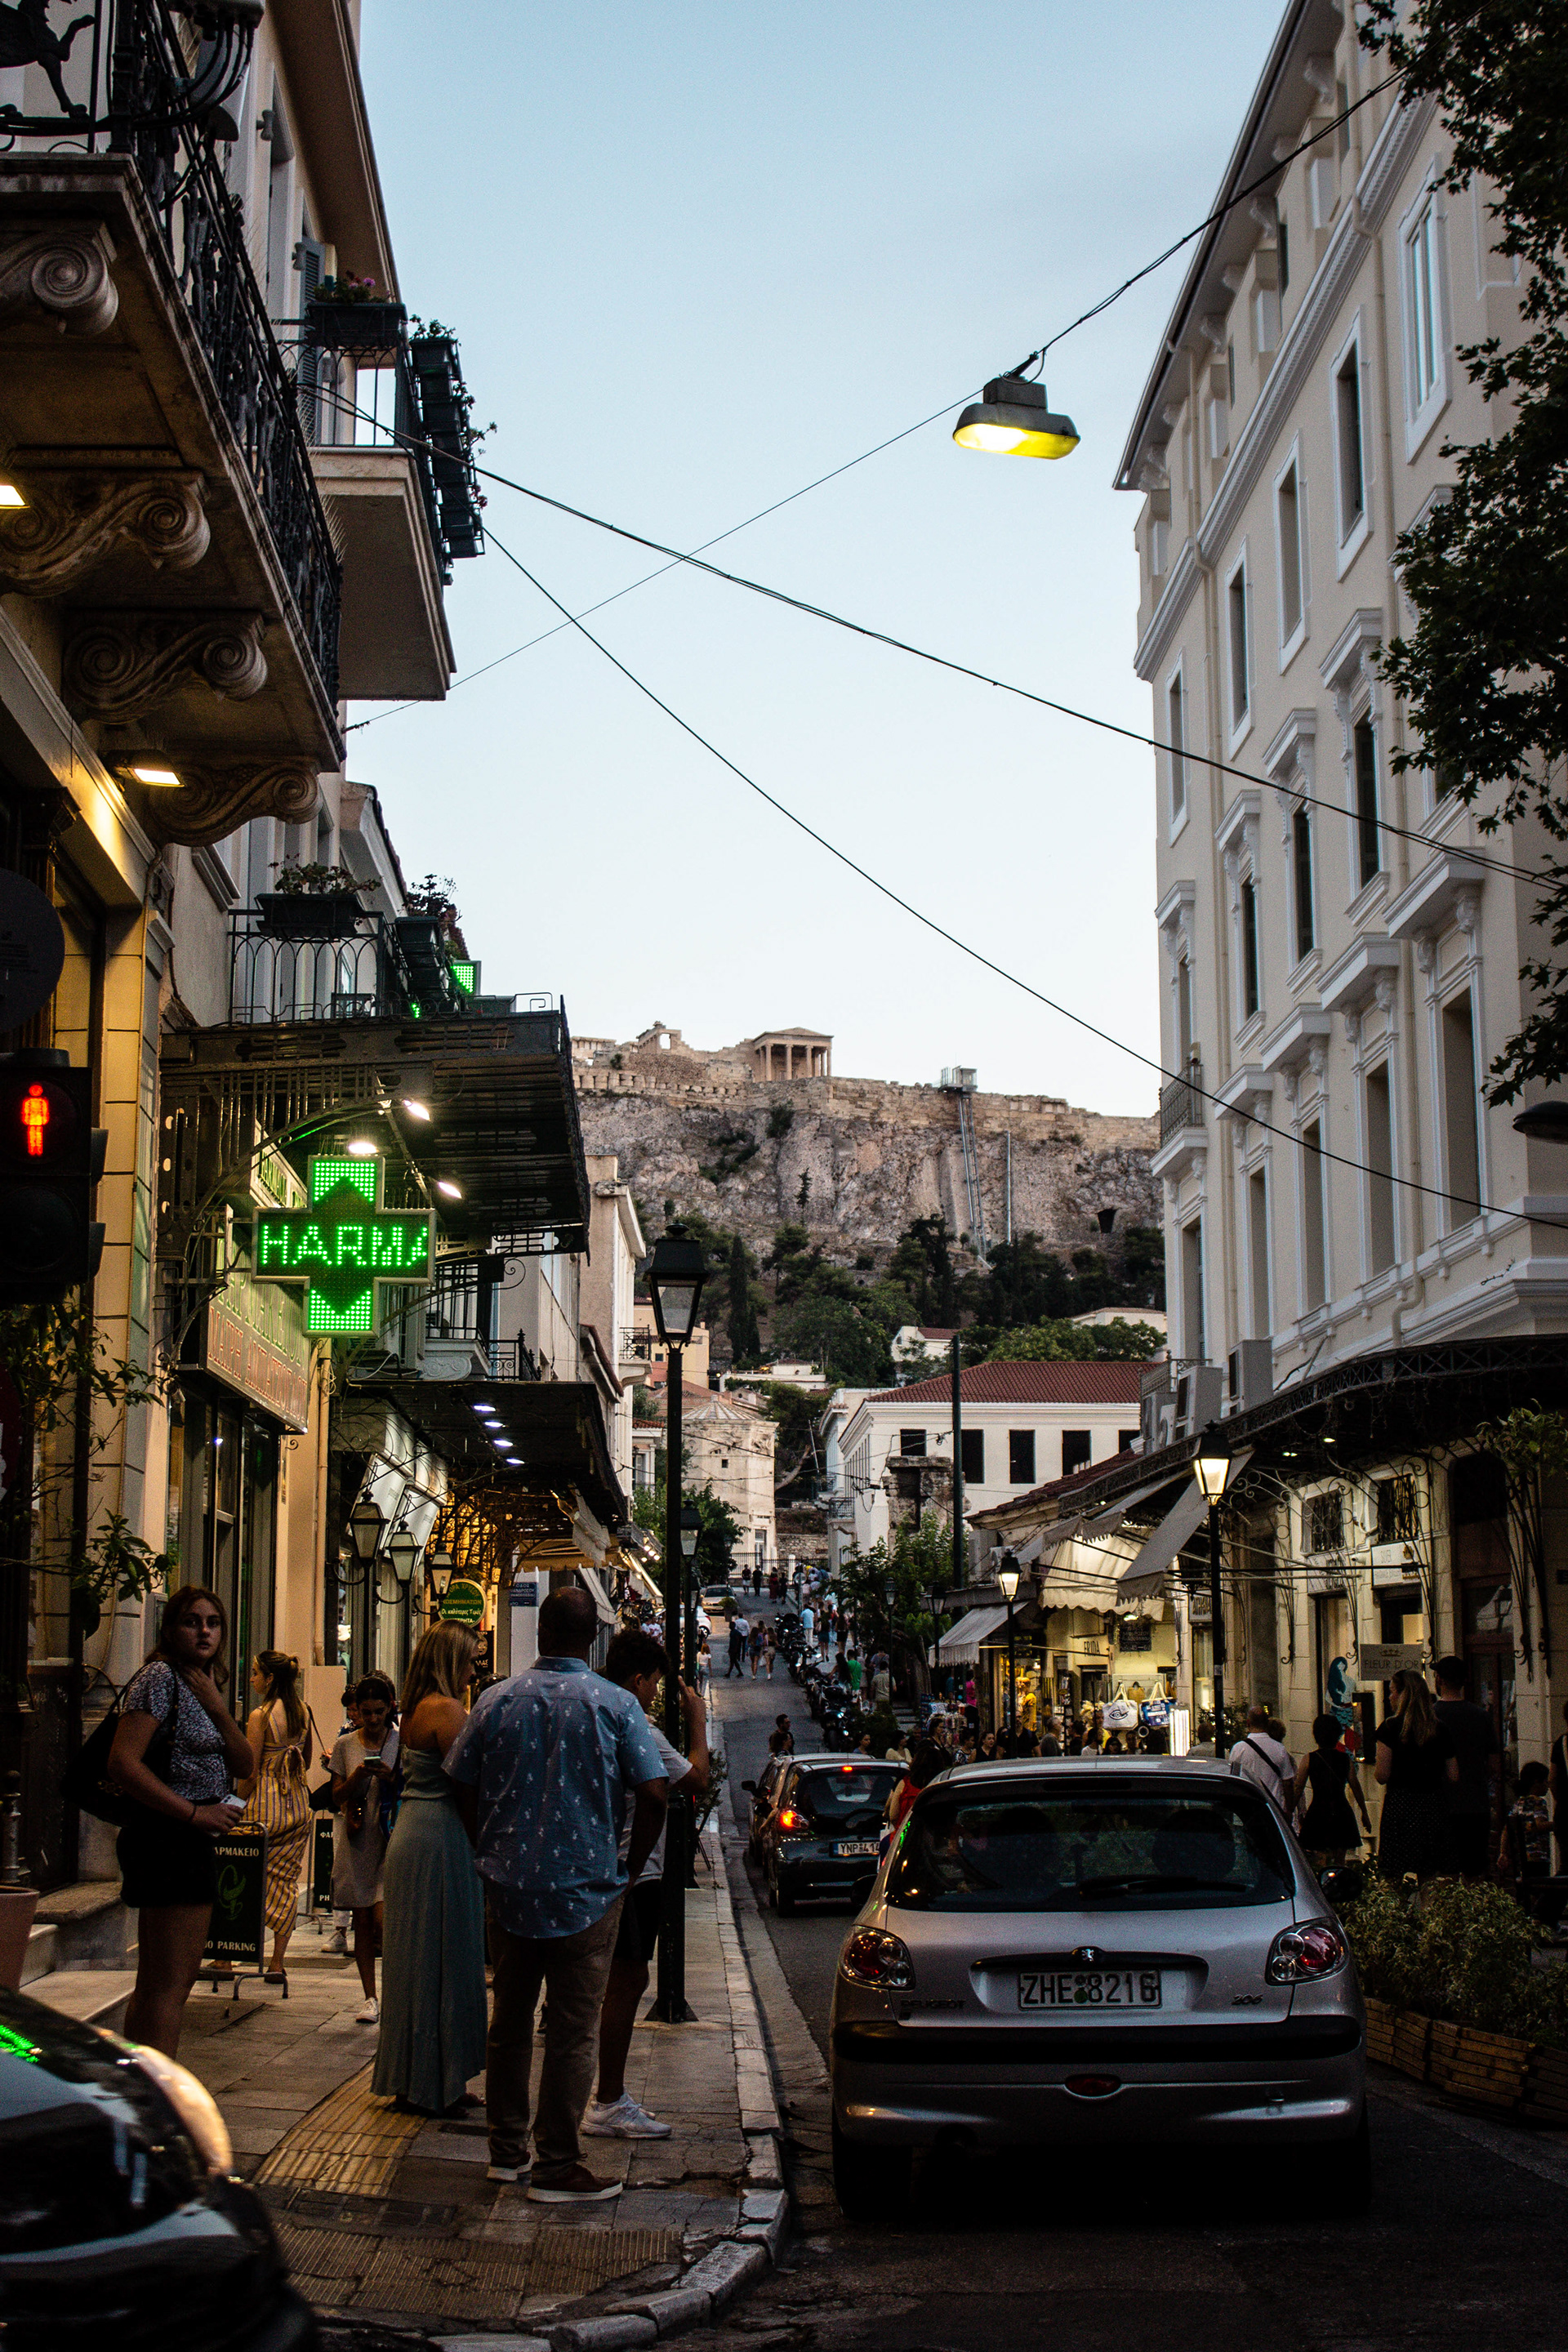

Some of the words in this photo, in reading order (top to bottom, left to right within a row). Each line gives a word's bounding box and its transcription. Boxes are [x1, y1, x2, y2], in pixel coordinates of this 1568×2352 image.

[1364, 1659, 1390, 1668] FLEUR
[1395, 1659, 1419, 1668] D'OR
[214, 1846, 259, 1857] ΑΡΜΑΚΕΙΟ
[217, 1941, 256, 1952] PARKING
[1023, 1975, 1073, 2003] ZHE
[901, 1999, 966, 2009] PEUGEOT
[1232, 1993, 1263, 2005] 206
